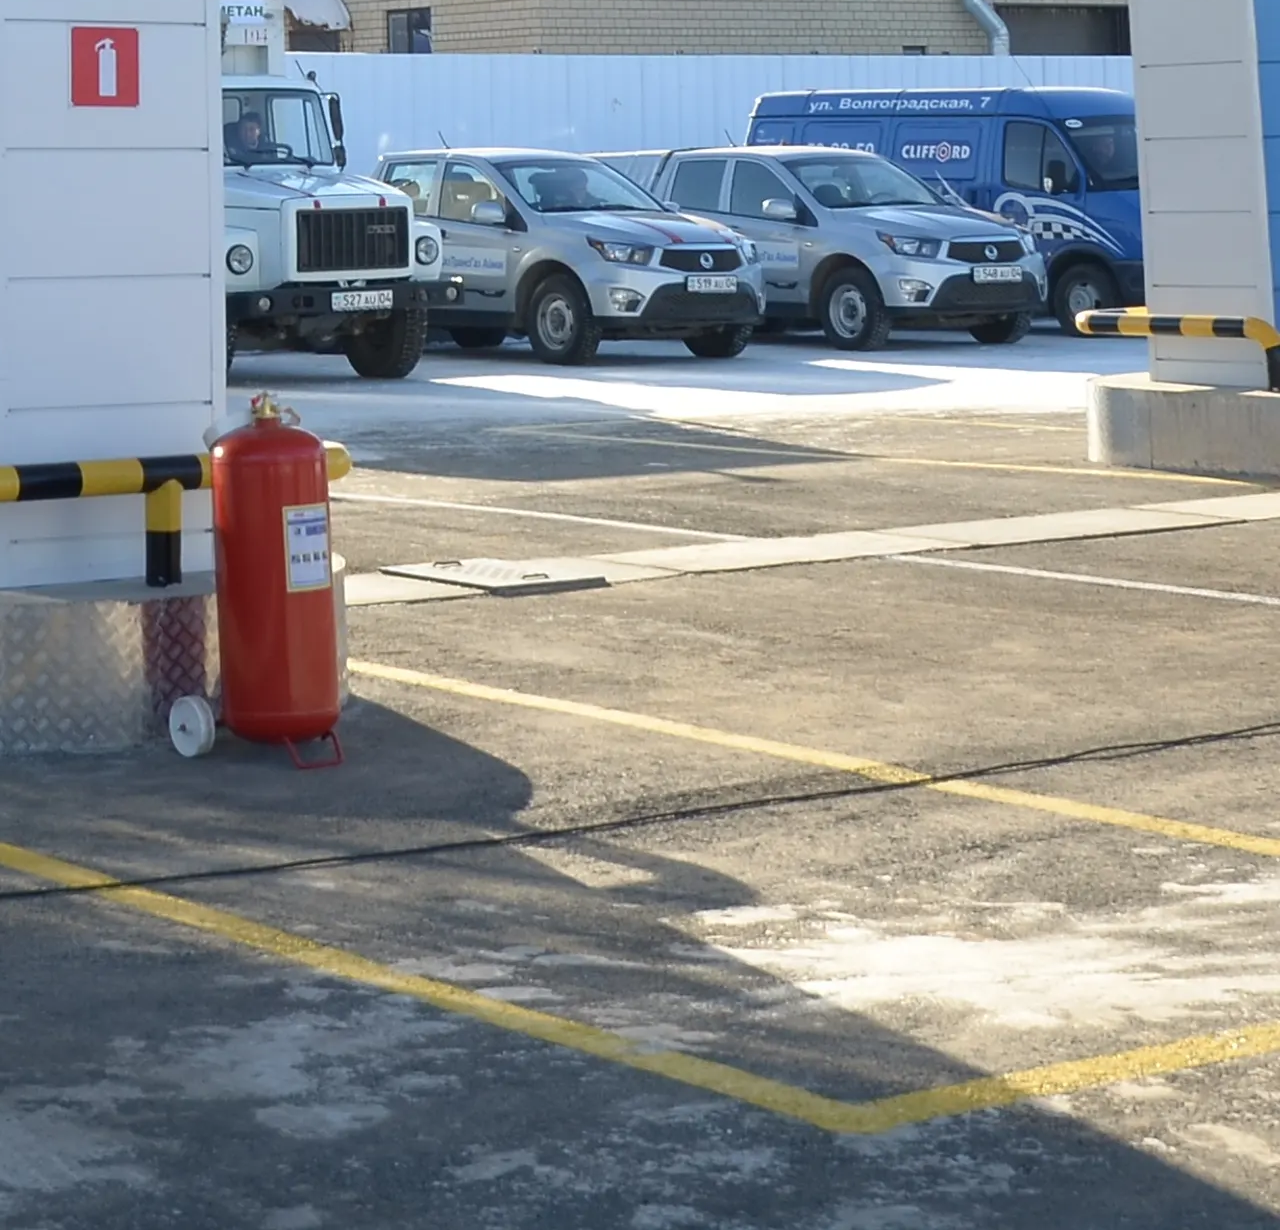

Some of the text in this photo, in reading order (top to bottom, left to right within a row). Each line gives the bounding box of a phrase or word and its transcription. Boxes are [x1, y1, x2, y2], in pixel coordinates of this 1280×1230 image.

[808, 96, 991, 113] ул. Волгоградская, 7
[901, 142, 971, 161] CLIFFORD
[343, 293, 362, 307] 527
[378, 292, 392, 304] 04
